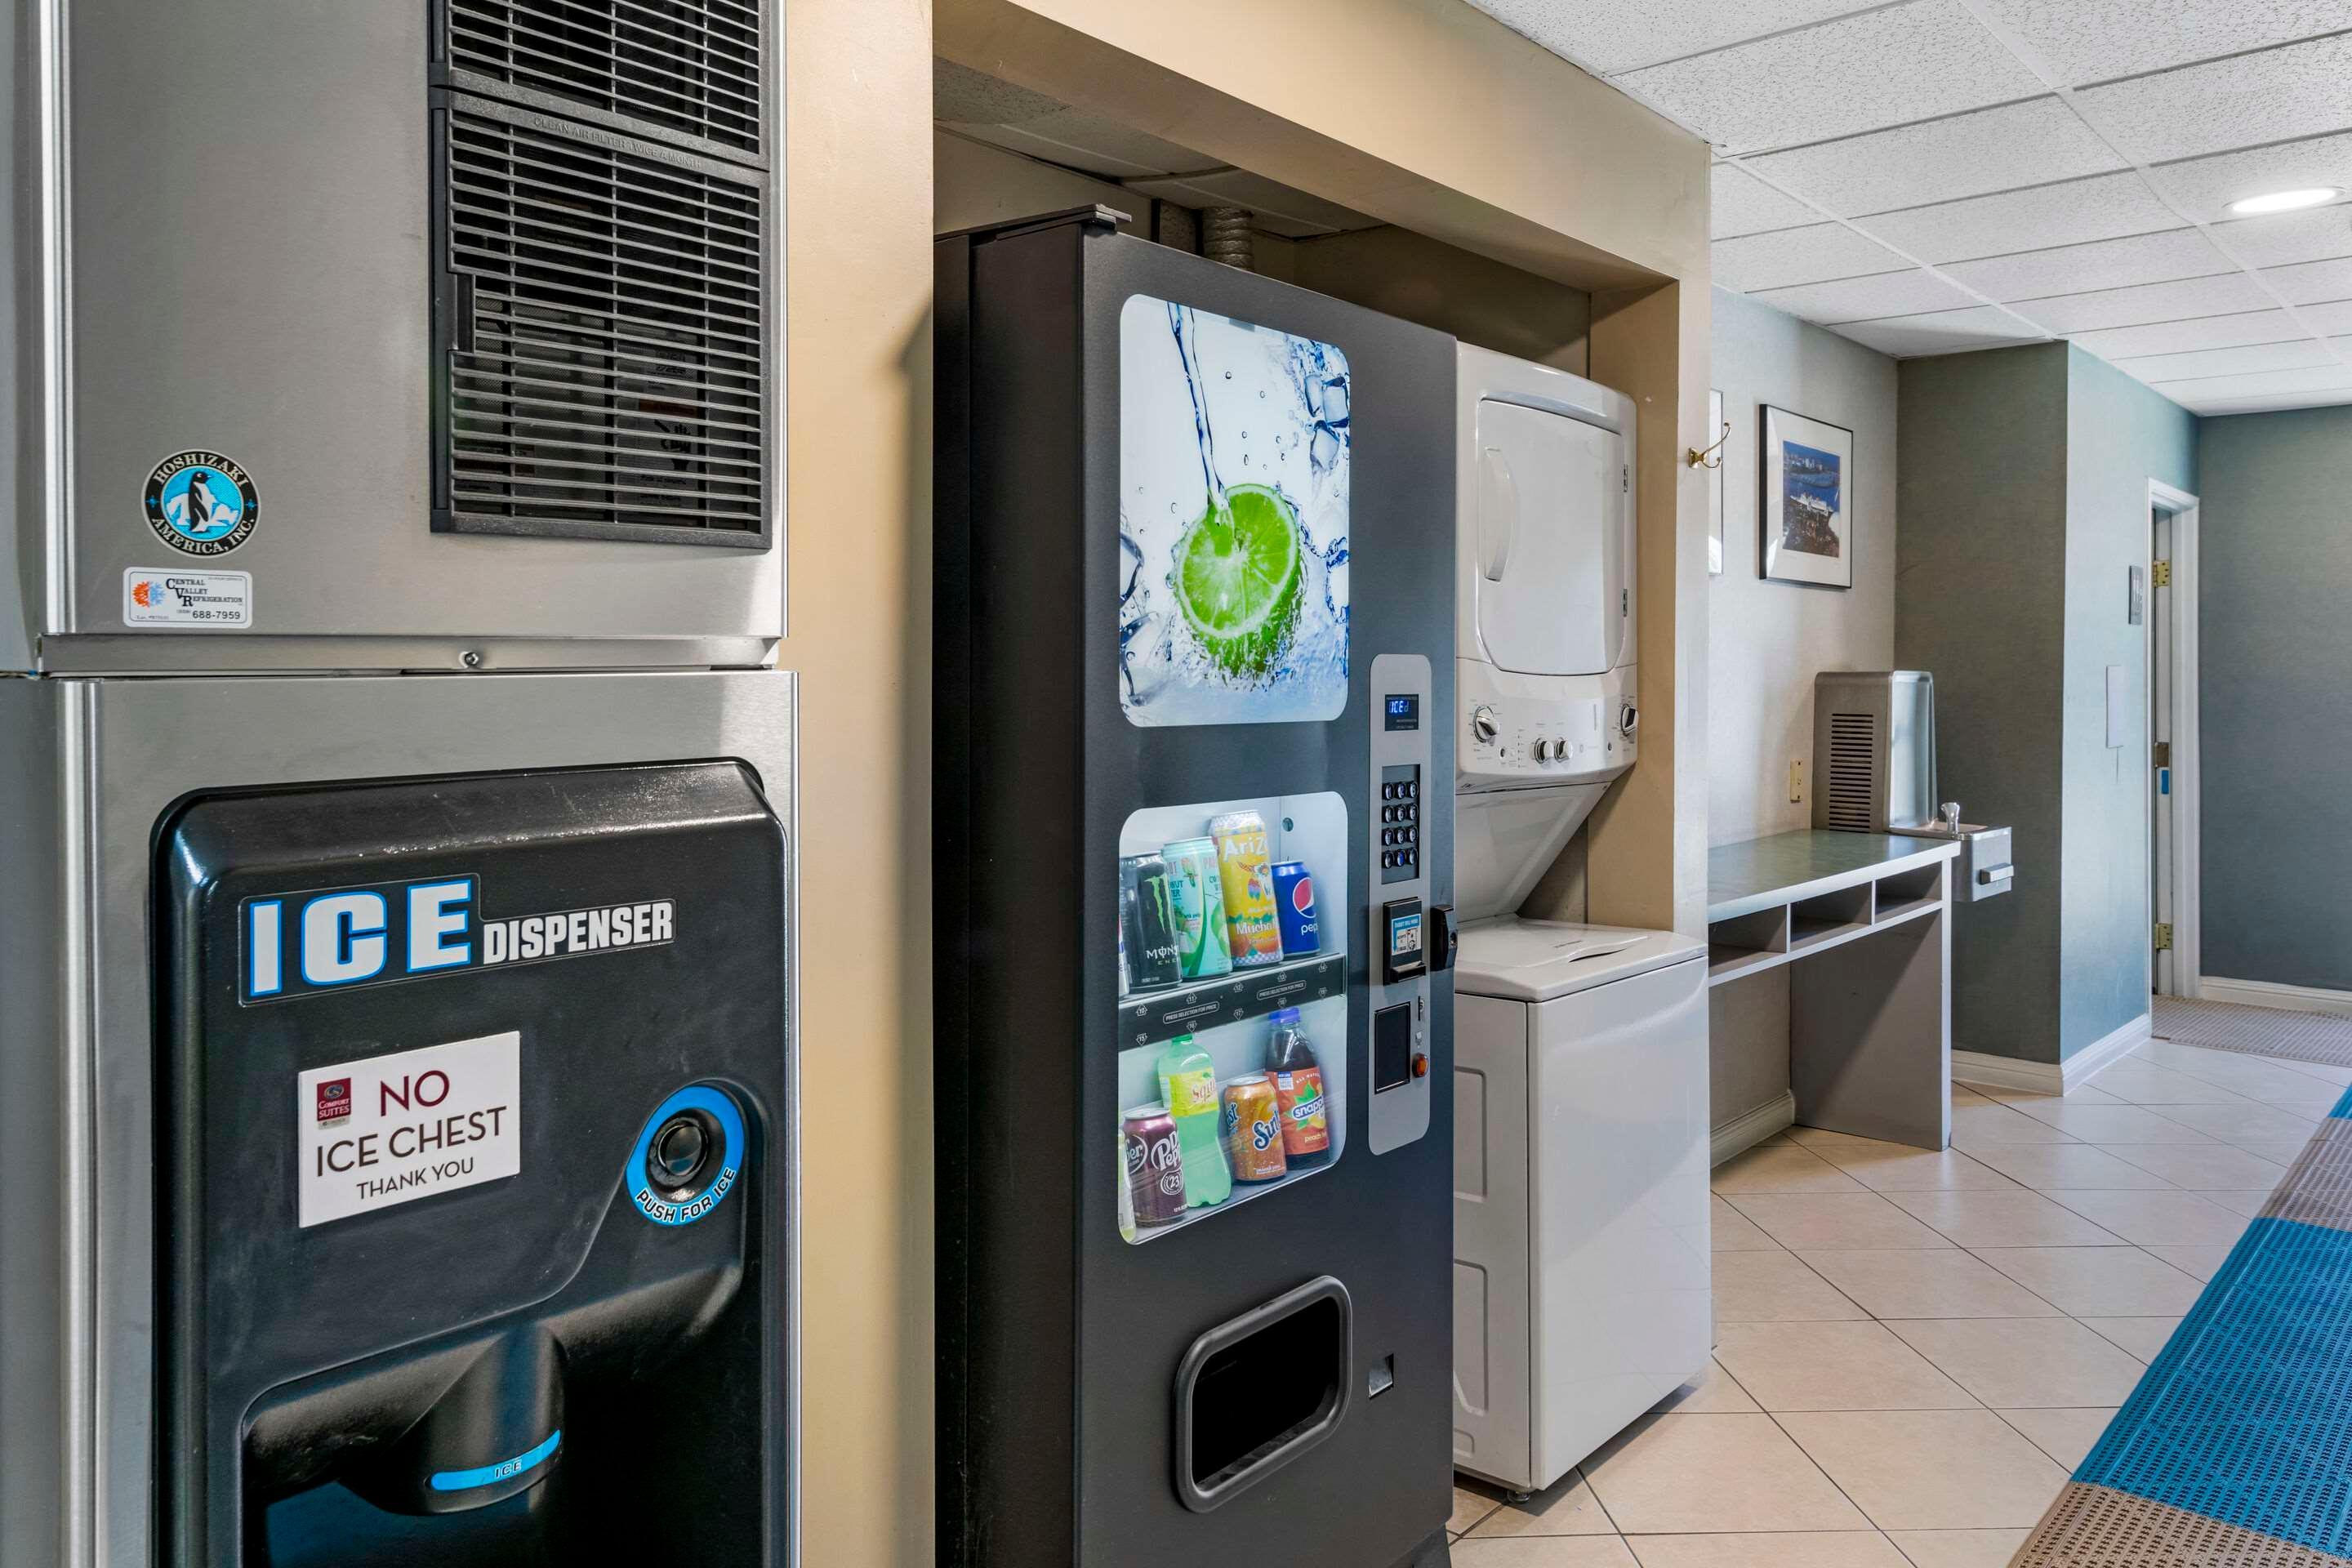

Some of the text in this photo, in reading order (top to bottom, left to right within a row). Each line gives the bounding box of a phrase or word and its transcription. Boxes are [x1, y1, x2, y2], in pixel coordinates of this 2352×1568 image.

[533, 117, 569, 135] CLEAN
[572, 127, 589, 140] AIR
[591, 130, 626, 149] FILTER
[629, 140, 657, 157] TWICE
[668, 152, 702, 168] MONTH
[154, 453, 249, 488] HOSHIZAKI
[152, 519, 255, 554] AMERICA, INC.
[192, 610, 241, 620] 688-7959
[250, 879, 673, 997] ICE DISPENSER
[319, 1105, 350, 1119] SUITES
[381, 1070, 450, 1117] NO
[318, 1106, 507, 1177] ICE CHEST
[357, 1157, 474, 1200] THANK YOU
[635, 1167, 737, 1223] PUSH FOR ICE
[1169, 1174, 1180, 1188] 23
[493, 1459, 523, 1480] ICE
